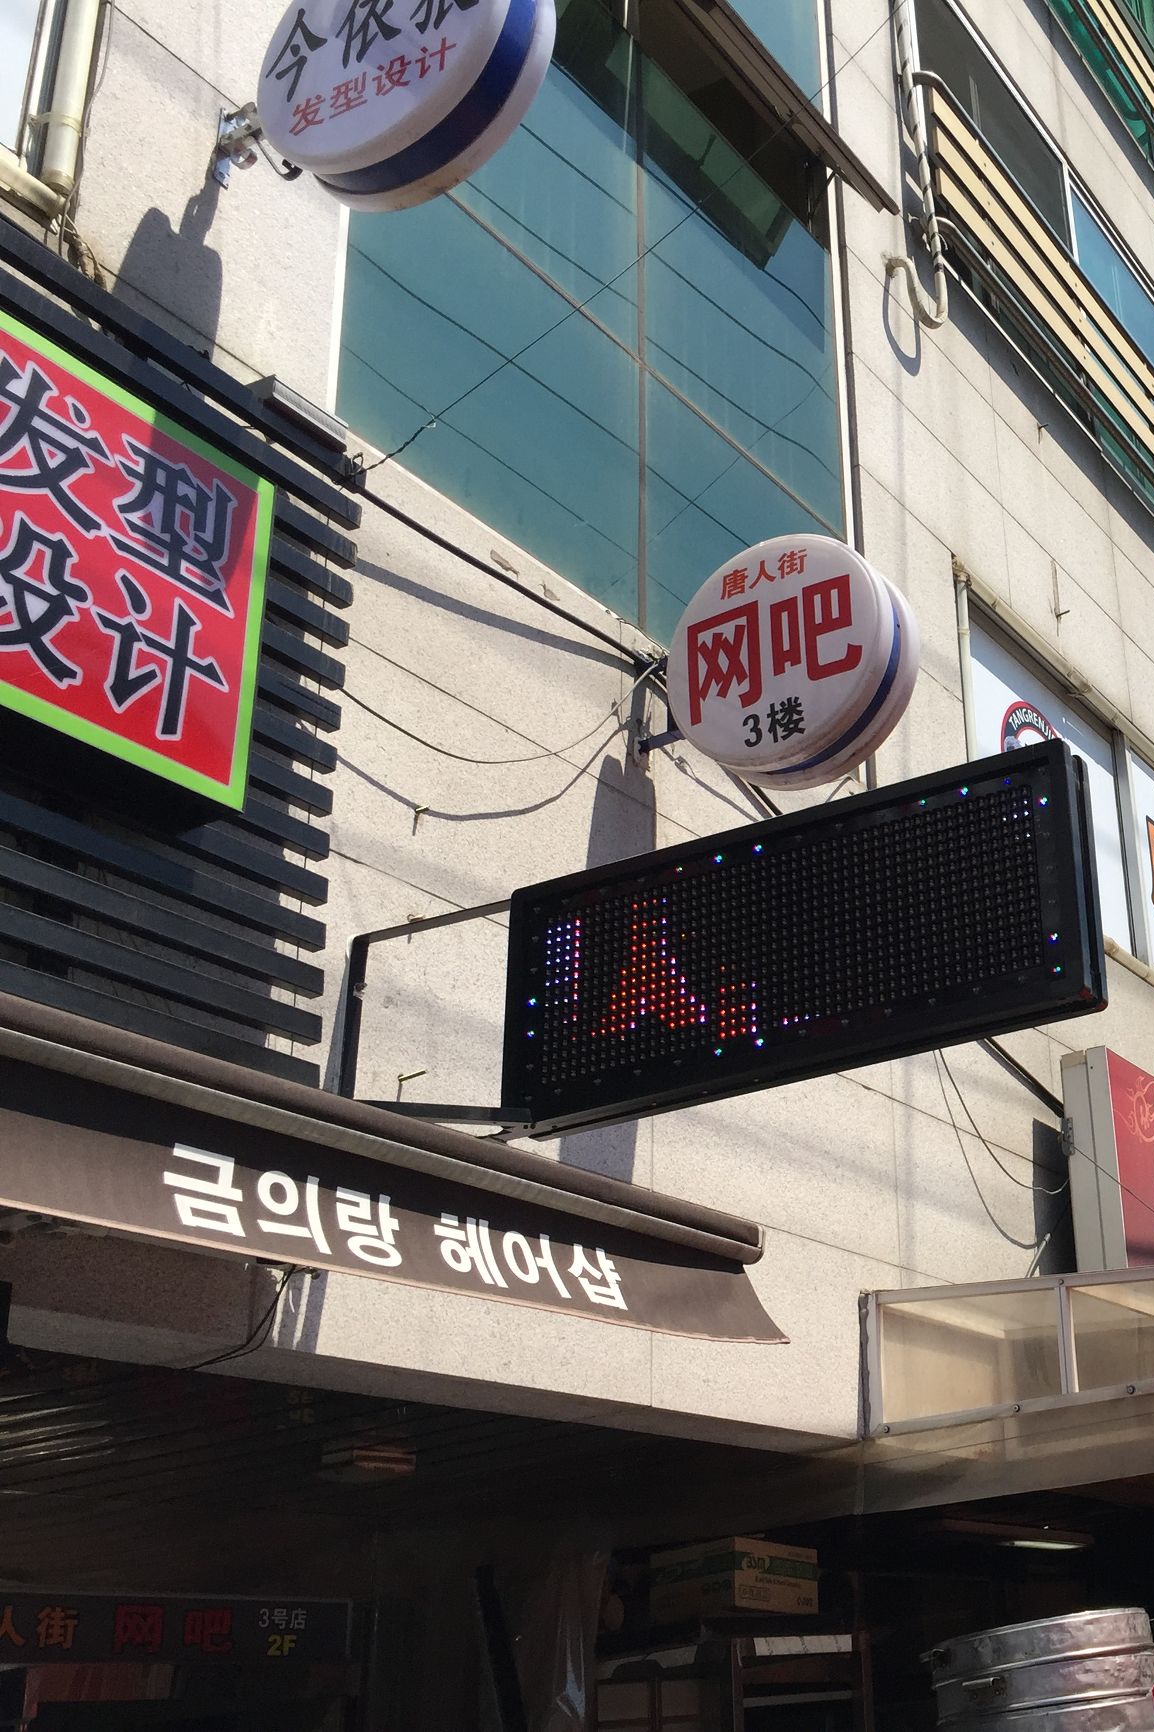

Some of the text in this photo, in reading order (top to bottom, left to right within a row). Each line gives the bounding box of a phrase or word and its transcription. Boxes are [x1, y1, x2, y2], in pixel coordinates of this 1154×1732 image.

[289, 36, 457, 137] 发型设计
[720, 549, 807, 600] 唐人街
[687, 574, 863, 727] 网吧
[742, 696, 806, 748] 3楼
[162, 1142, 628, 1310] 금의랑 헤어샵
[113, 1604, 233, 1654] 网吧
[258, 1607, 308, 1631] 3号店
[267, 1633, 297, 1656] 2F
